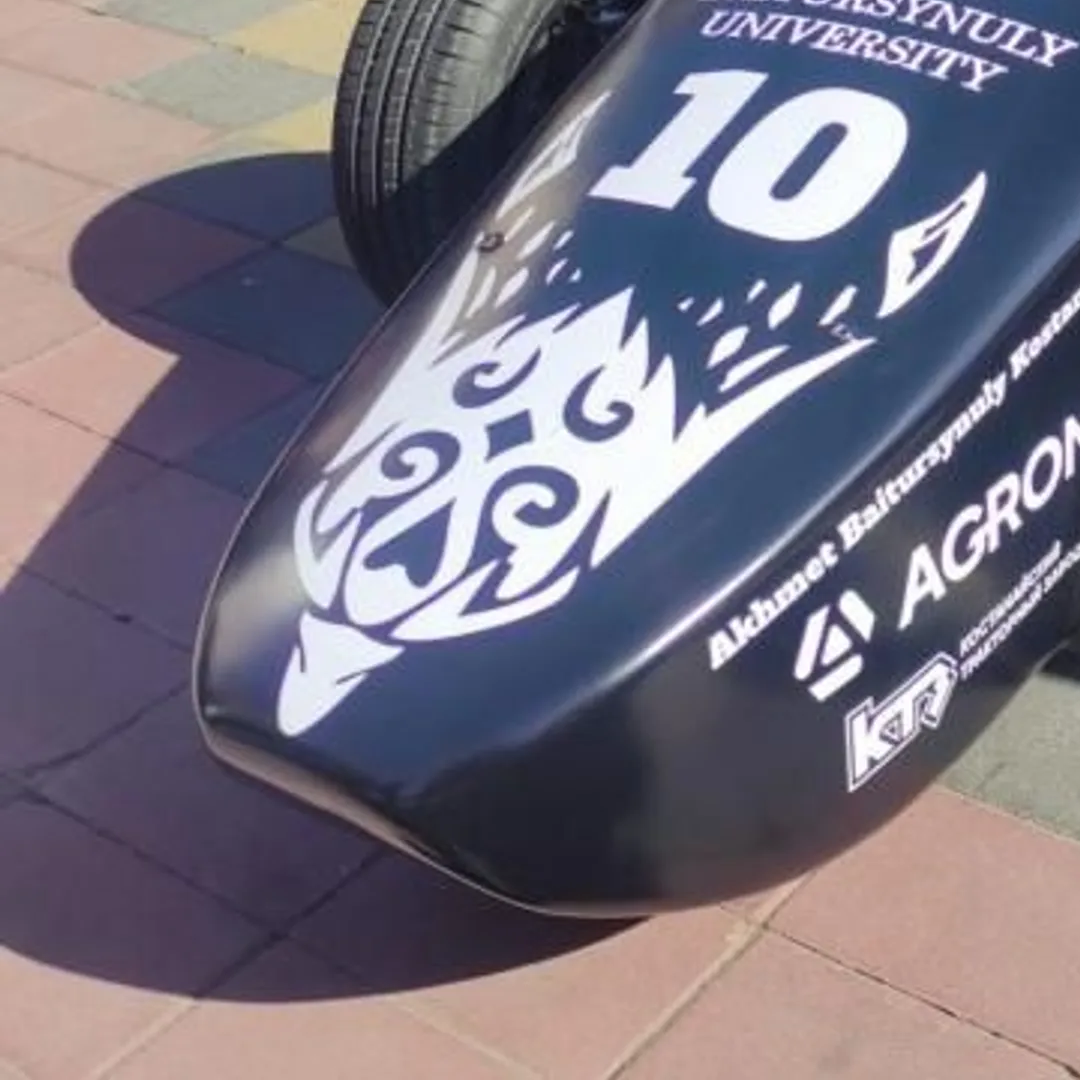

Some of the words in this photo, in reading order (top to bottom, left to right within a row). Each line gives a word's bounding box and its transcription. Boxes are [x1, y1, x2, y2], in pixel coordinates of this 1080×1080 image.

[700, 10, 1009, 92] UNIVERSITY
[588, 69, 908, 242] 10
[707, 540, 841, 671] Akhmet
[837, 370, 1008, 552] Baitursynuly
